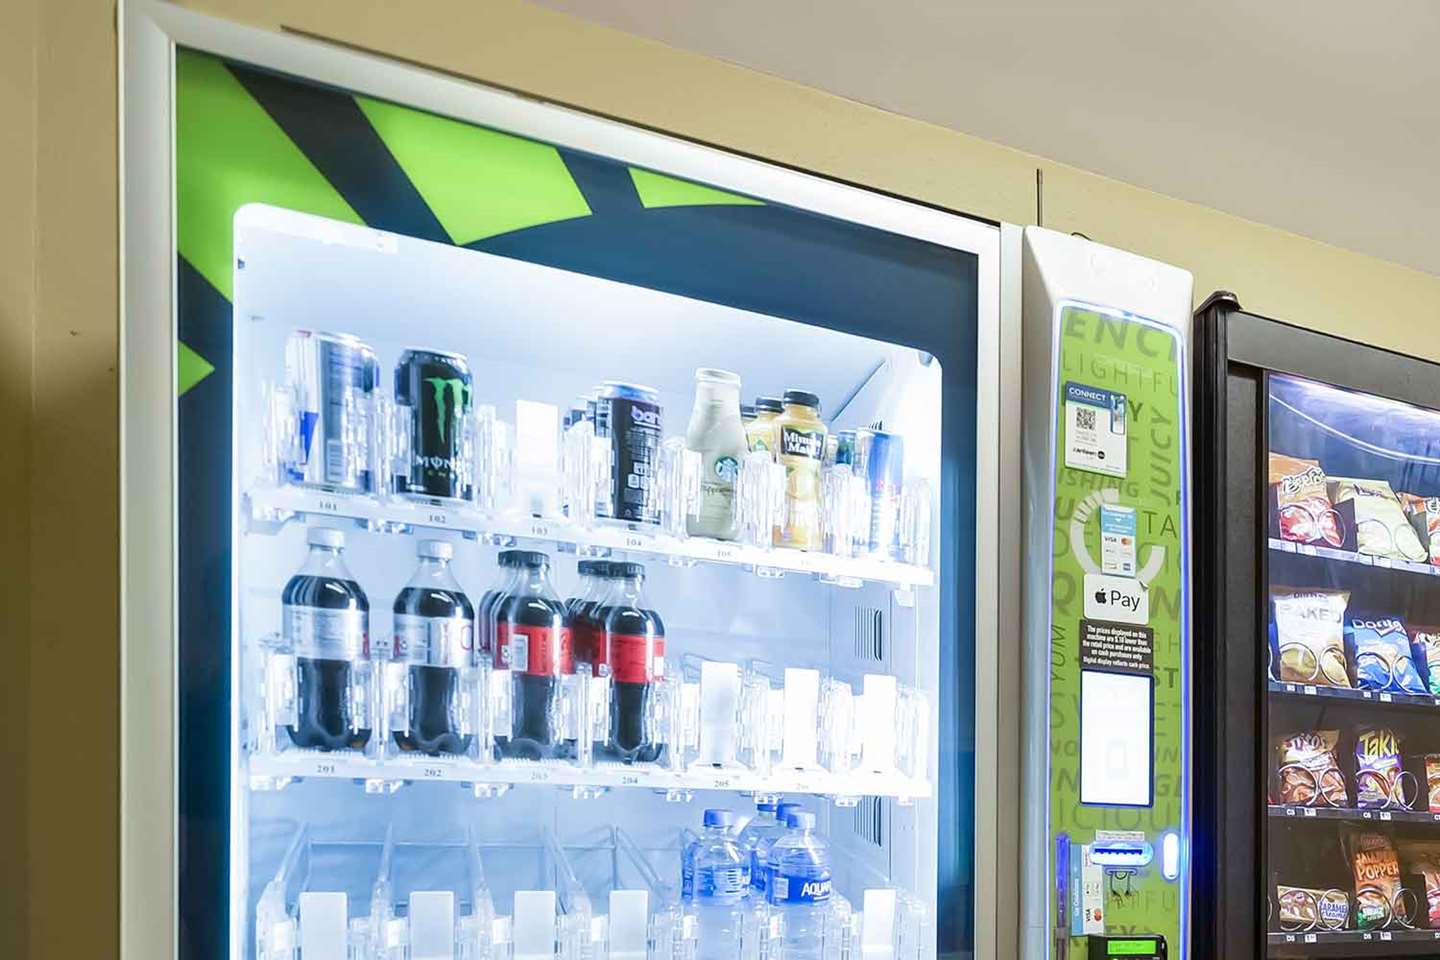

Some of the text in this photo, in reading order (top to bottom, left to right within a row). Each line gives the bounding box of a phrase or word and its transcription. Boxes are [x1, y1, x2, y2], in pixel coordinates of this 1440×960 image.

[1069, 387, 1106, 401] CONNECT
[320, 501, 337, 511] 101
[428, 514, 446, 523] 102
[1111, 590, 1140, 612] Pay
[317, 765, 335, 774] 201
[424, 769, 442, 778] 202
